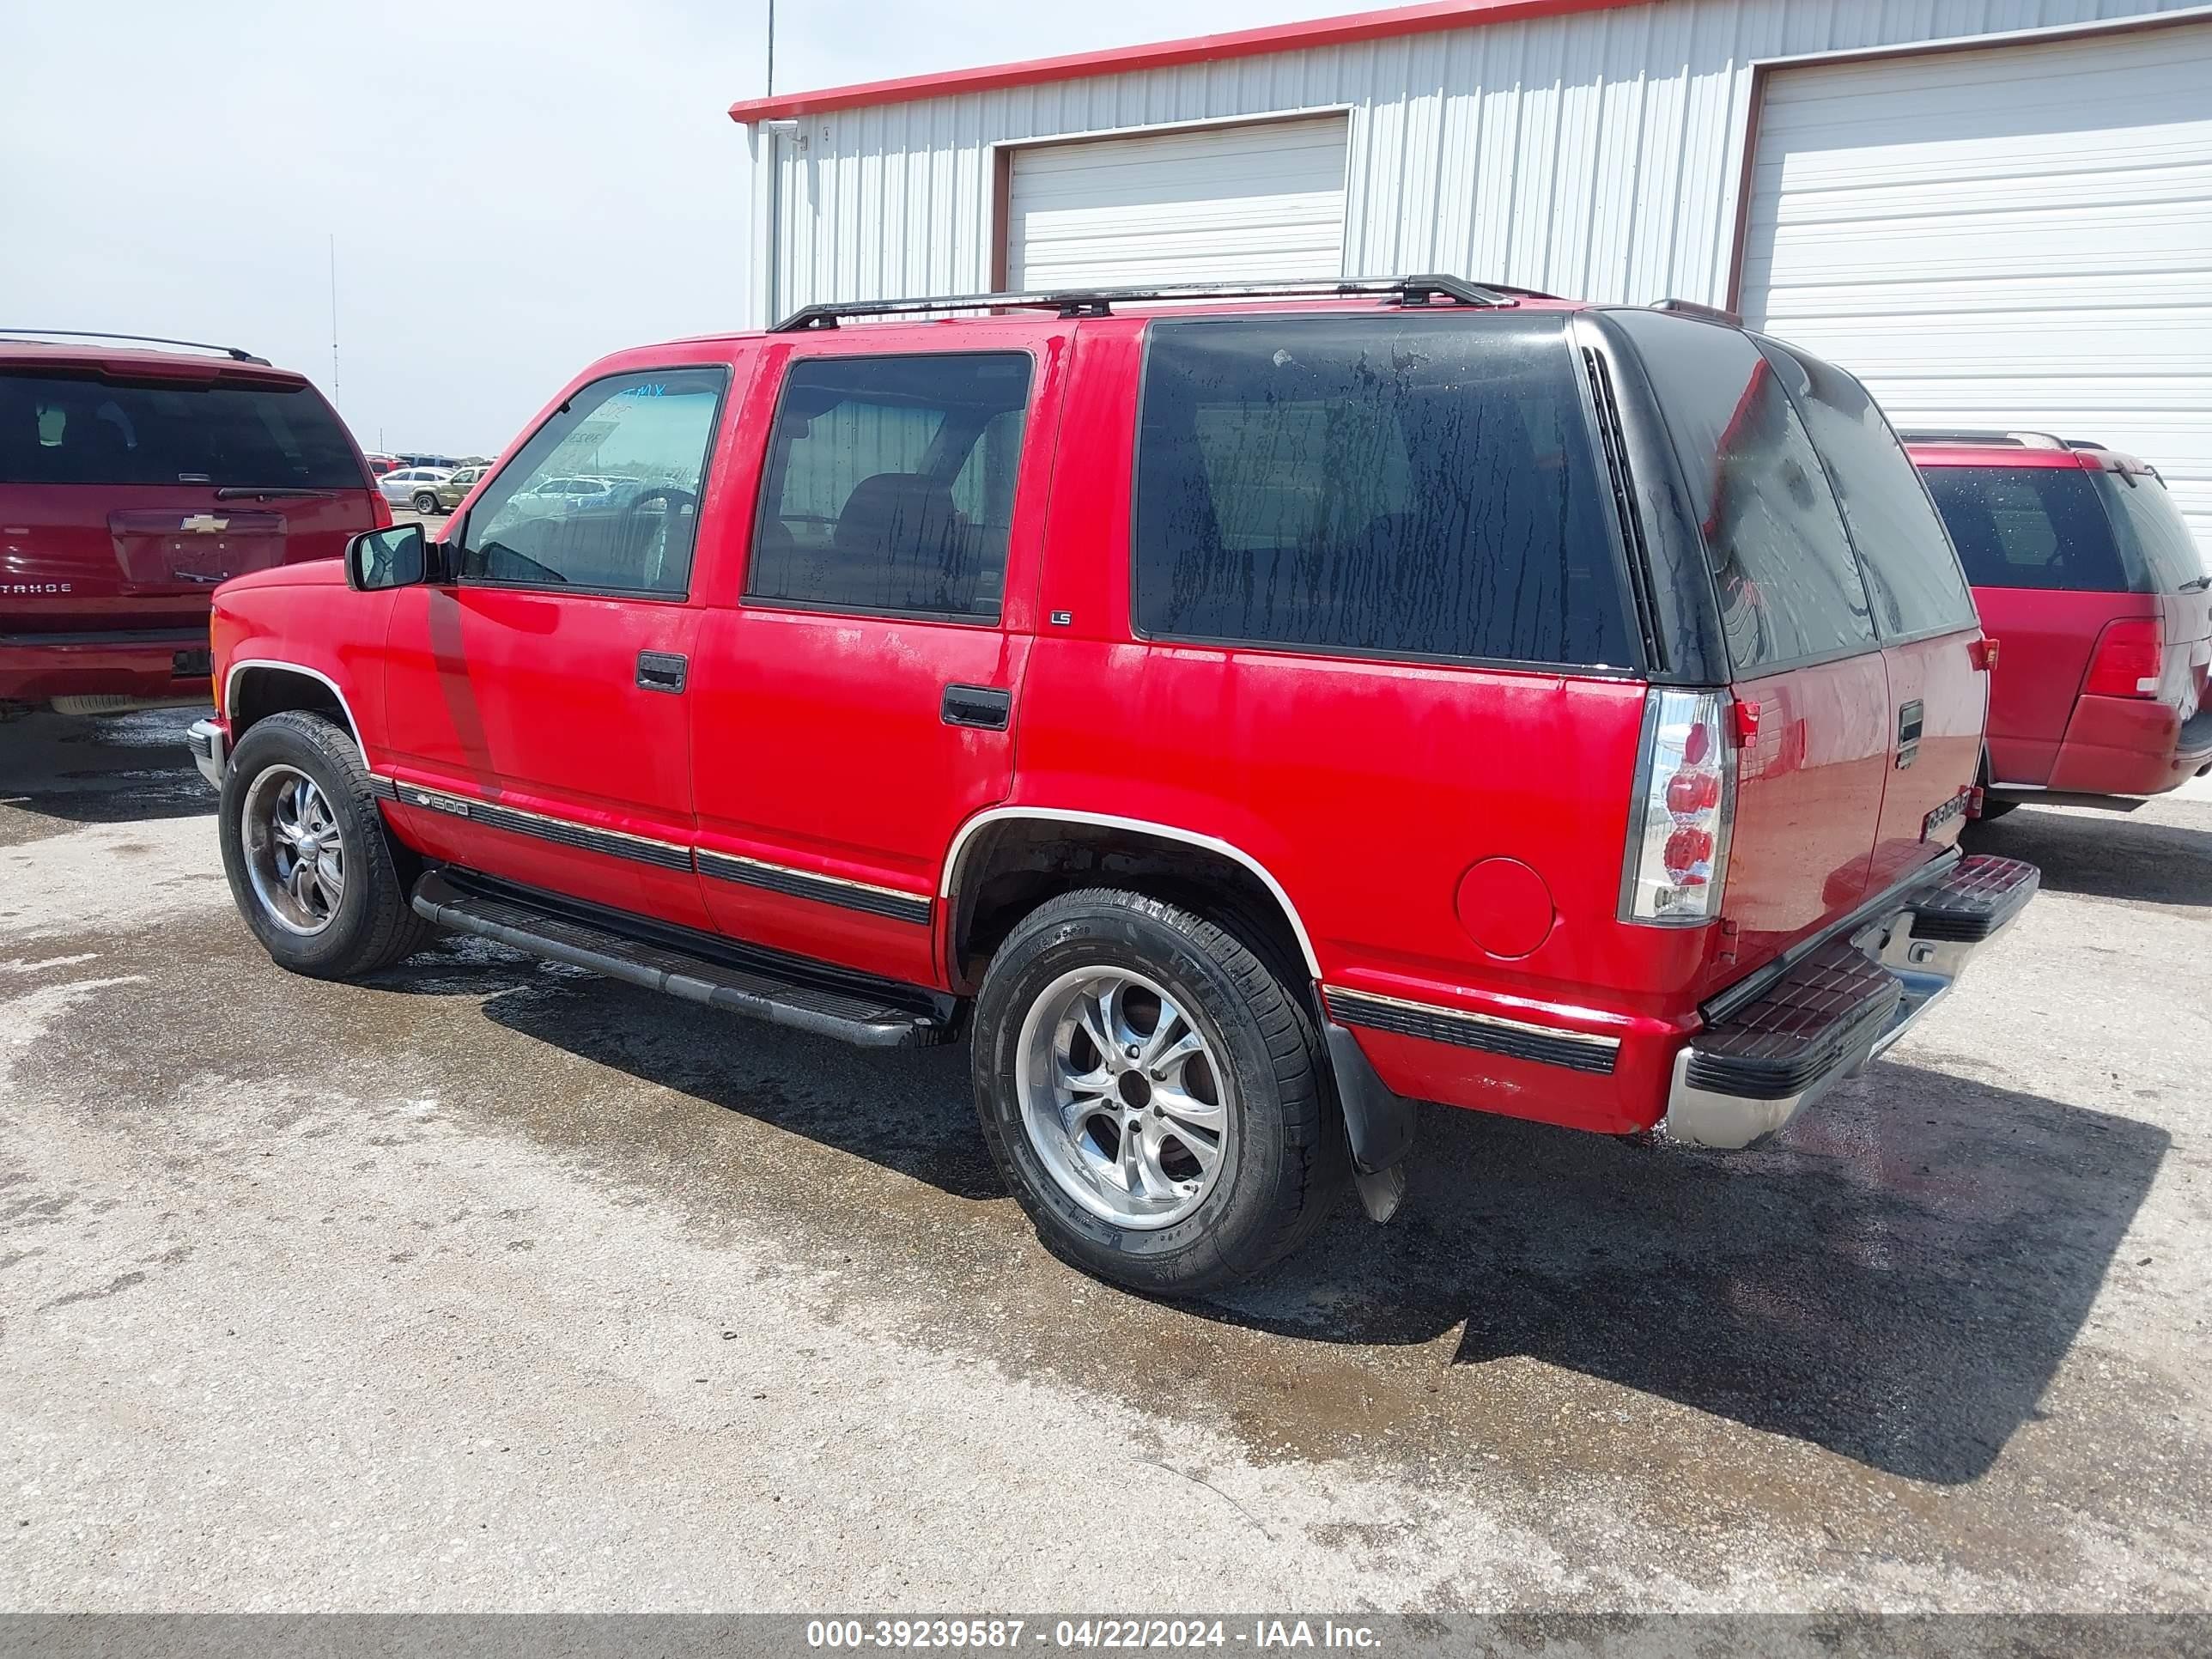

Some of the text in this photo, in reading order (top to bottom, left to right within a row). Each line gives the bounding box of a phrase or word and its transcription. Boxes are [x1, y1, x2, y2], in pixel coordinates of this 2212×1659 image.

[0, 583, 72, 594] TAHOE
[1051, 613, 1071, 624] LS
[429, 796, 469, 816] 1500
